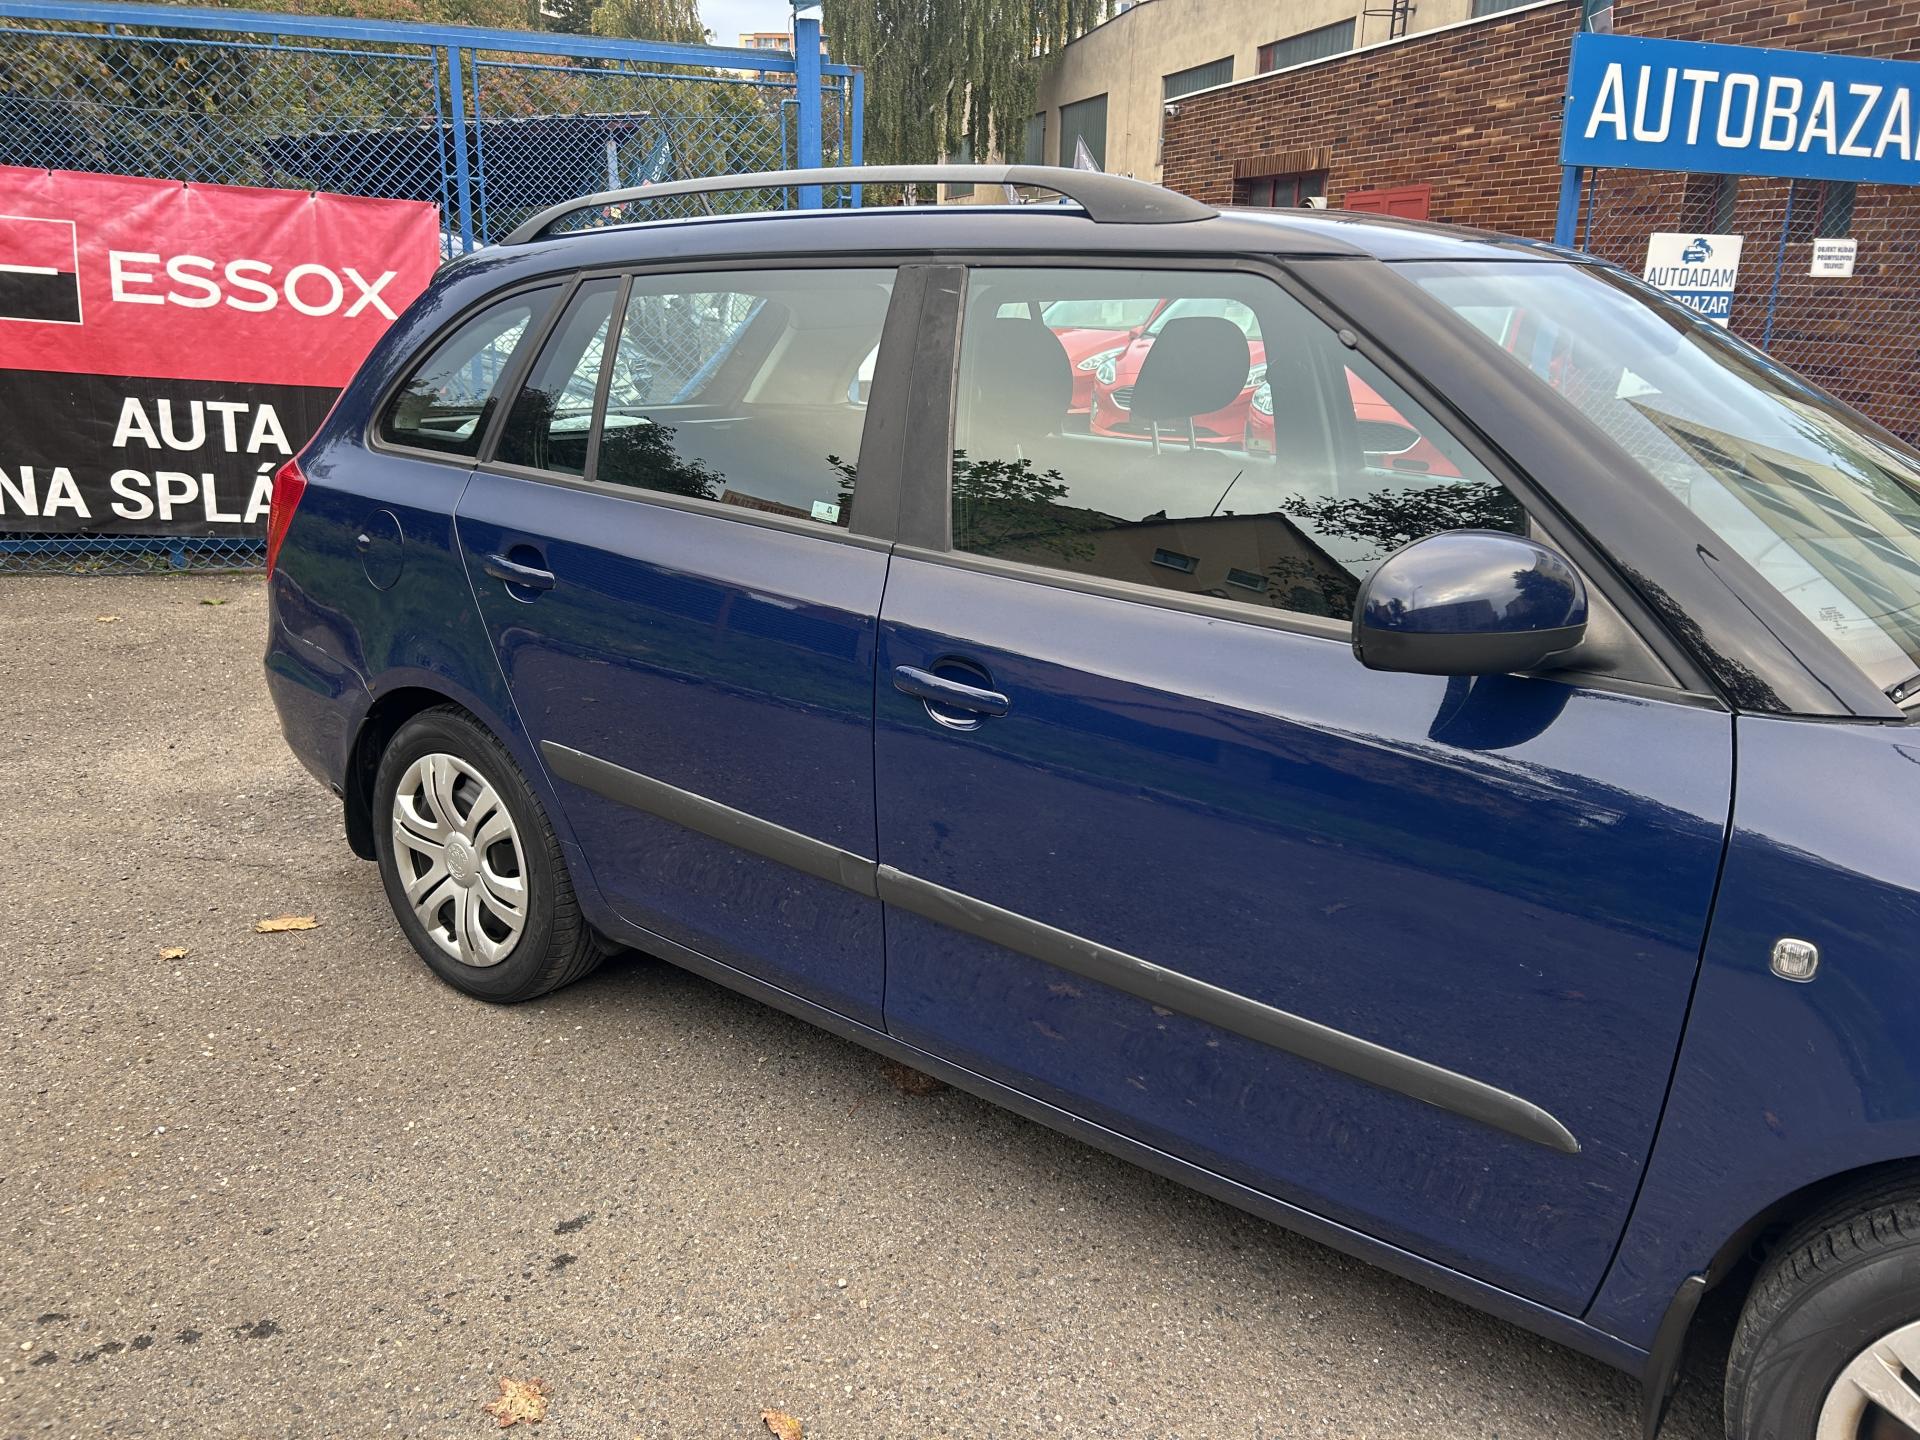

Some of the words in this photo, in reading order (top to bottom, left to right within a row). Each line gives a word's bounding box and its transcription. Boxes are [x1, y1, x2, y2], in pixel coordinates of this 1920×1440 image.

[1584, 62, 1920, 161] AUTOBAZA
[109, 250, 398, 320] ESSOX
[1647, 267, 1735, 287] AUTOADAM
[112, 397, 293, 455] AUTA
[0, 465, 92, 518] NA
